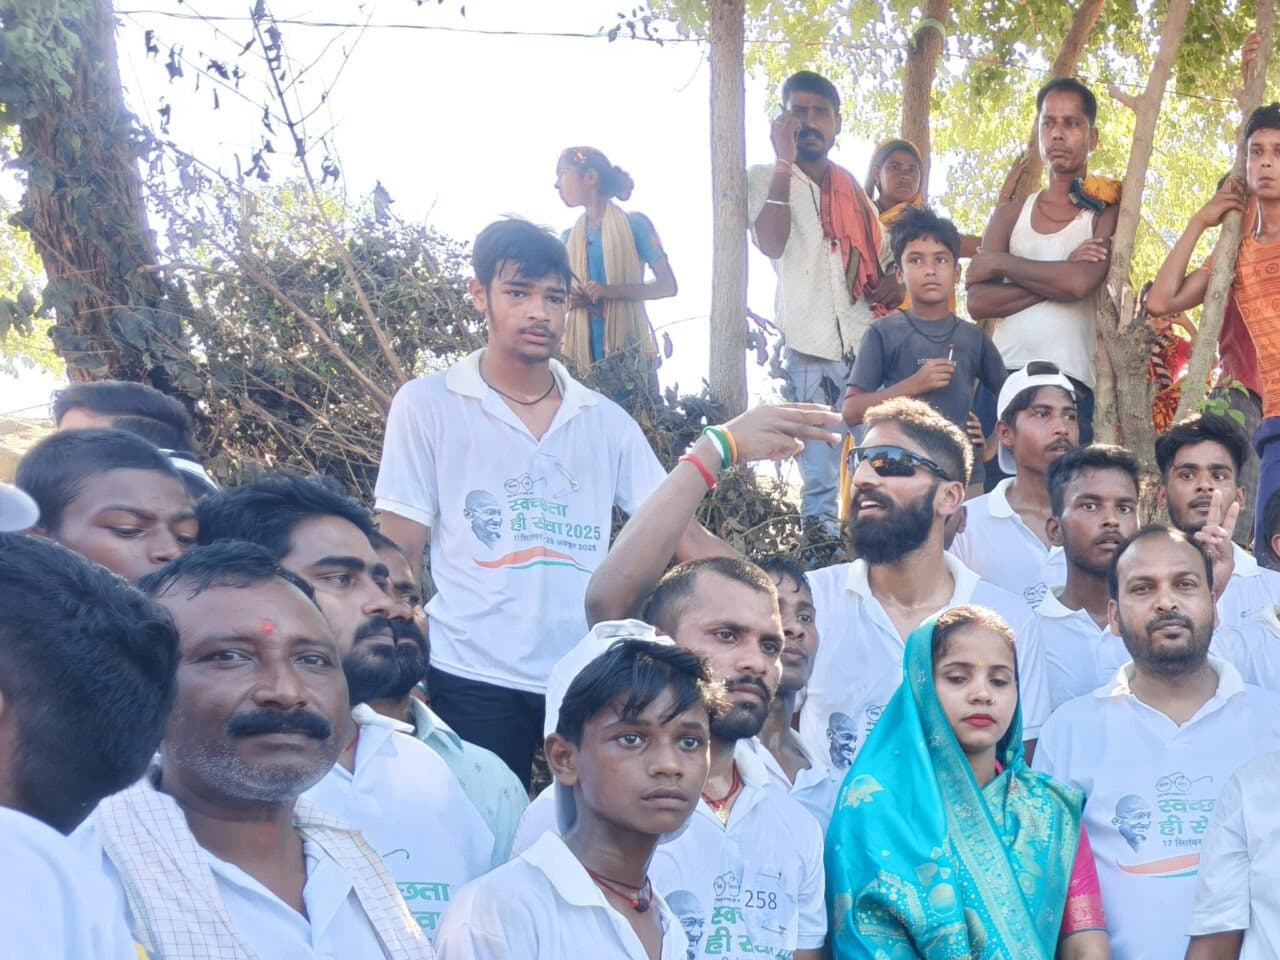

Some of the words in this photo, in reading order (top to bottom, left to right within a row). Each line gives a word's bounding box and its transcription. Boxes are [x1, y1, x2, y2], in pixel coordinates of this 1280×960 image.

[566, 523, 601, 540] 2025
[1158, 799, 1217, 813] स्वच्छ
[1158, 815, 1184, 835] ही
[1189, 816, 1209, 834] से
[745, 889, 777, 910] 258
[705, 926, 732, 955] ही
